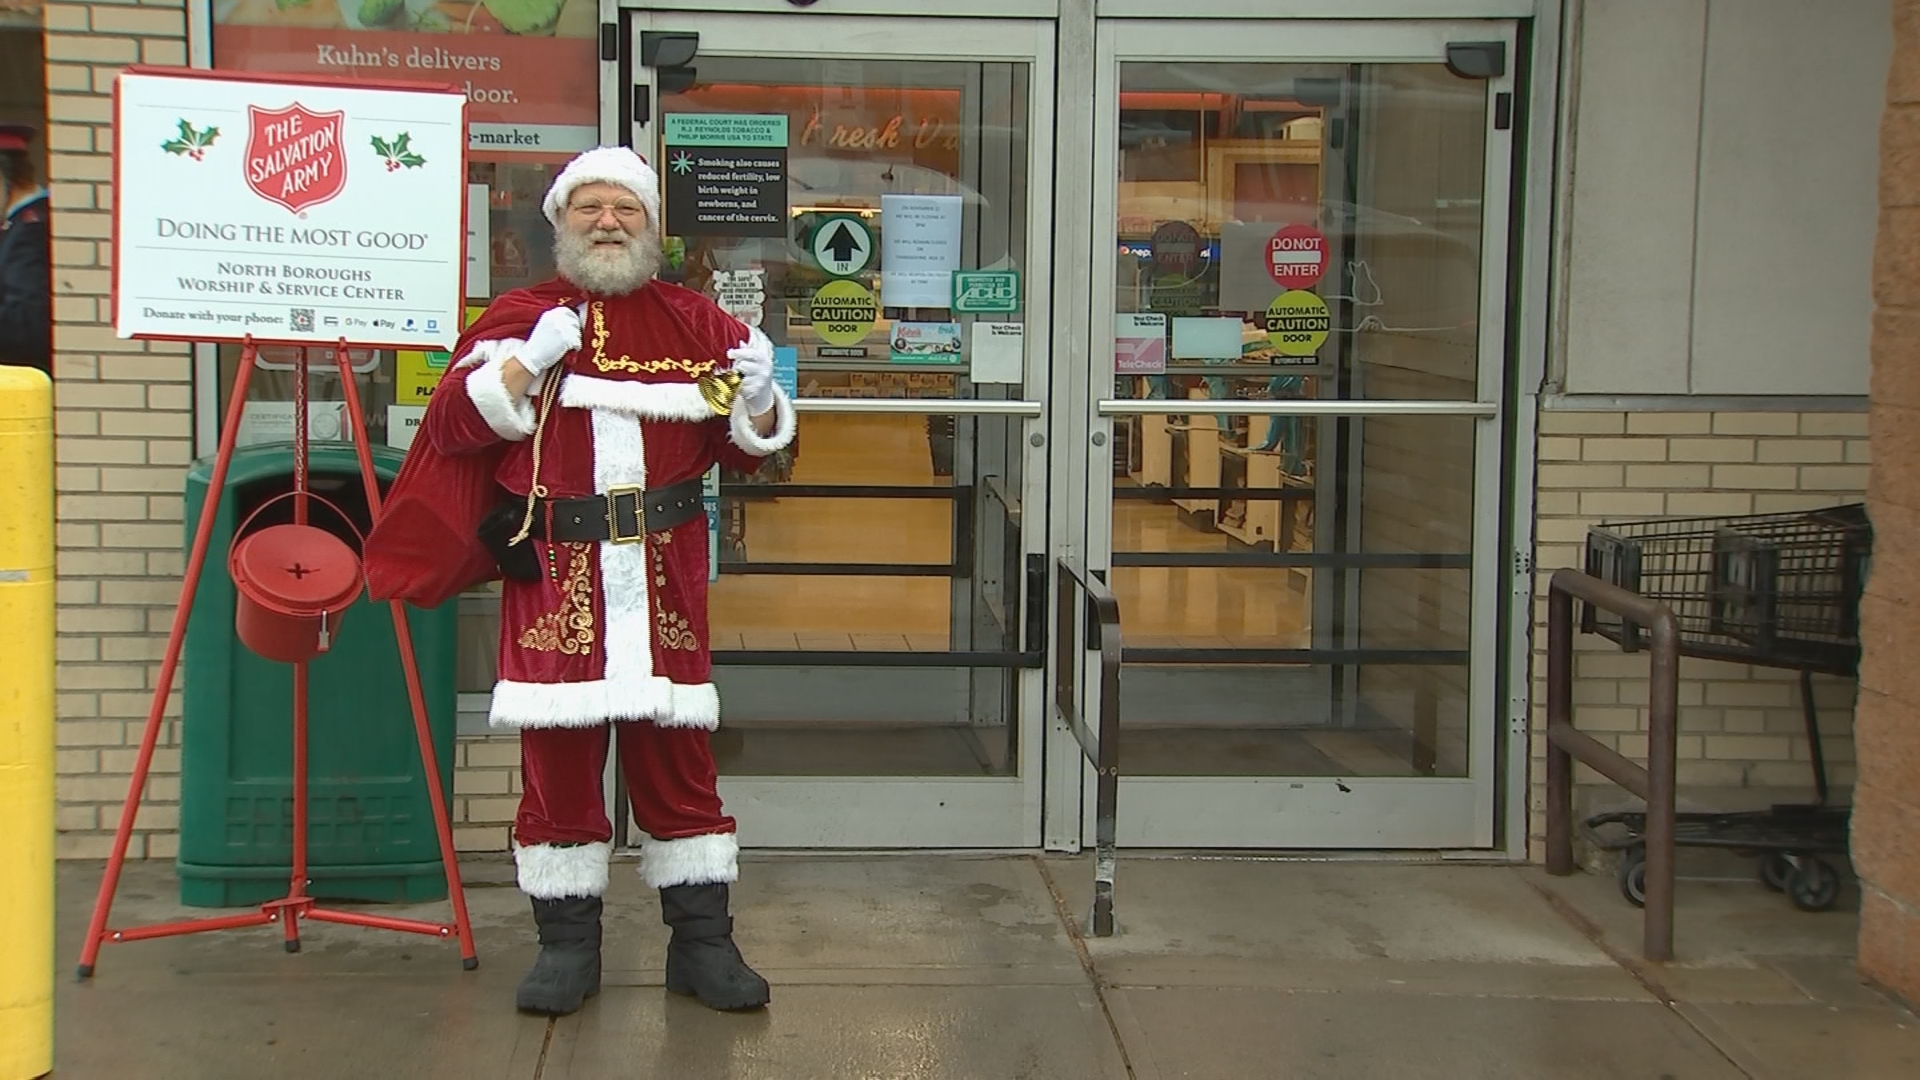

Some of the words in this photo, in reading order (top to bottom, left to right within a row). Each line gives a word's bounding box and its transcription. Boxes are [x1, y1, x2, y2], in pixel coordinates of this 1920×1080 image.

[317, 44, 399, 67] Kuhn's
[405, 47, 501, 70] delivers
[264, 114, 303, 147] THE
[251, 120, 336, 183] SALVATION
[698, 158, 735, 168] Smoking
[735, 158, 752, 167] also
[753, 160, 780, 168] causes
[281, 151, 333, 199] ARMY
[698, 172, 730, 180] reduced
[731, 172, 765, 183] fertility,
[766, 173, 781, 181] low
[698, 186, 719, 194] birth
[720, 186, 748, 196] weight
[698, 200, 741, 209] newborns,
[741, 200, 757, 208] and
[726, 213, 735, 222] of
[735, 214, 749, 222] the
[750, 214, 779, 222] cervix.
[157, 218, 236, 240] DOING
[241, 225, 285, 243] THE
[290, 228, 352, 247] MOST
[1272, 238, 1292, 250] DO
[1293, 238, 1321, 250] NOT
[836, 262, 849, 271] IN
[1274, 264, 1319, 276] ENTER
[217, 262, 277, 278] NORTH
[282, 265, 372, 282] BOROUGHS
[177, 277, 255, 294] WORSHIP
[259, 281, 273, 294] &
[276, 281, 339, 298] SERVICE
[343, 285, 405, 300] CENTER
[813, 297, 871, 305] AUTOMATIC
[143, 307, 186, 319] Donate
[188, 310, 214, 320] with
[216, 313, 242, 324] your
[245, 313, 284, 325] phone:
[812, 308, 874, 320] CAUTION
[1268, 306, 1326, 316] AUTOMATIC
[354, 319, 368, 327] Pay
[380, 319, 396, 329] Pay
[828, 324, 858, 332] DOOR
[1267, 318, 1328, 331] CAUTION
[1283, 334, 1312, 342] DOOR
[1118, 359, 1162, 368] TeleCheck
[416, 386, 436, 396] PLA
[405, 418, 421, 427] DR
